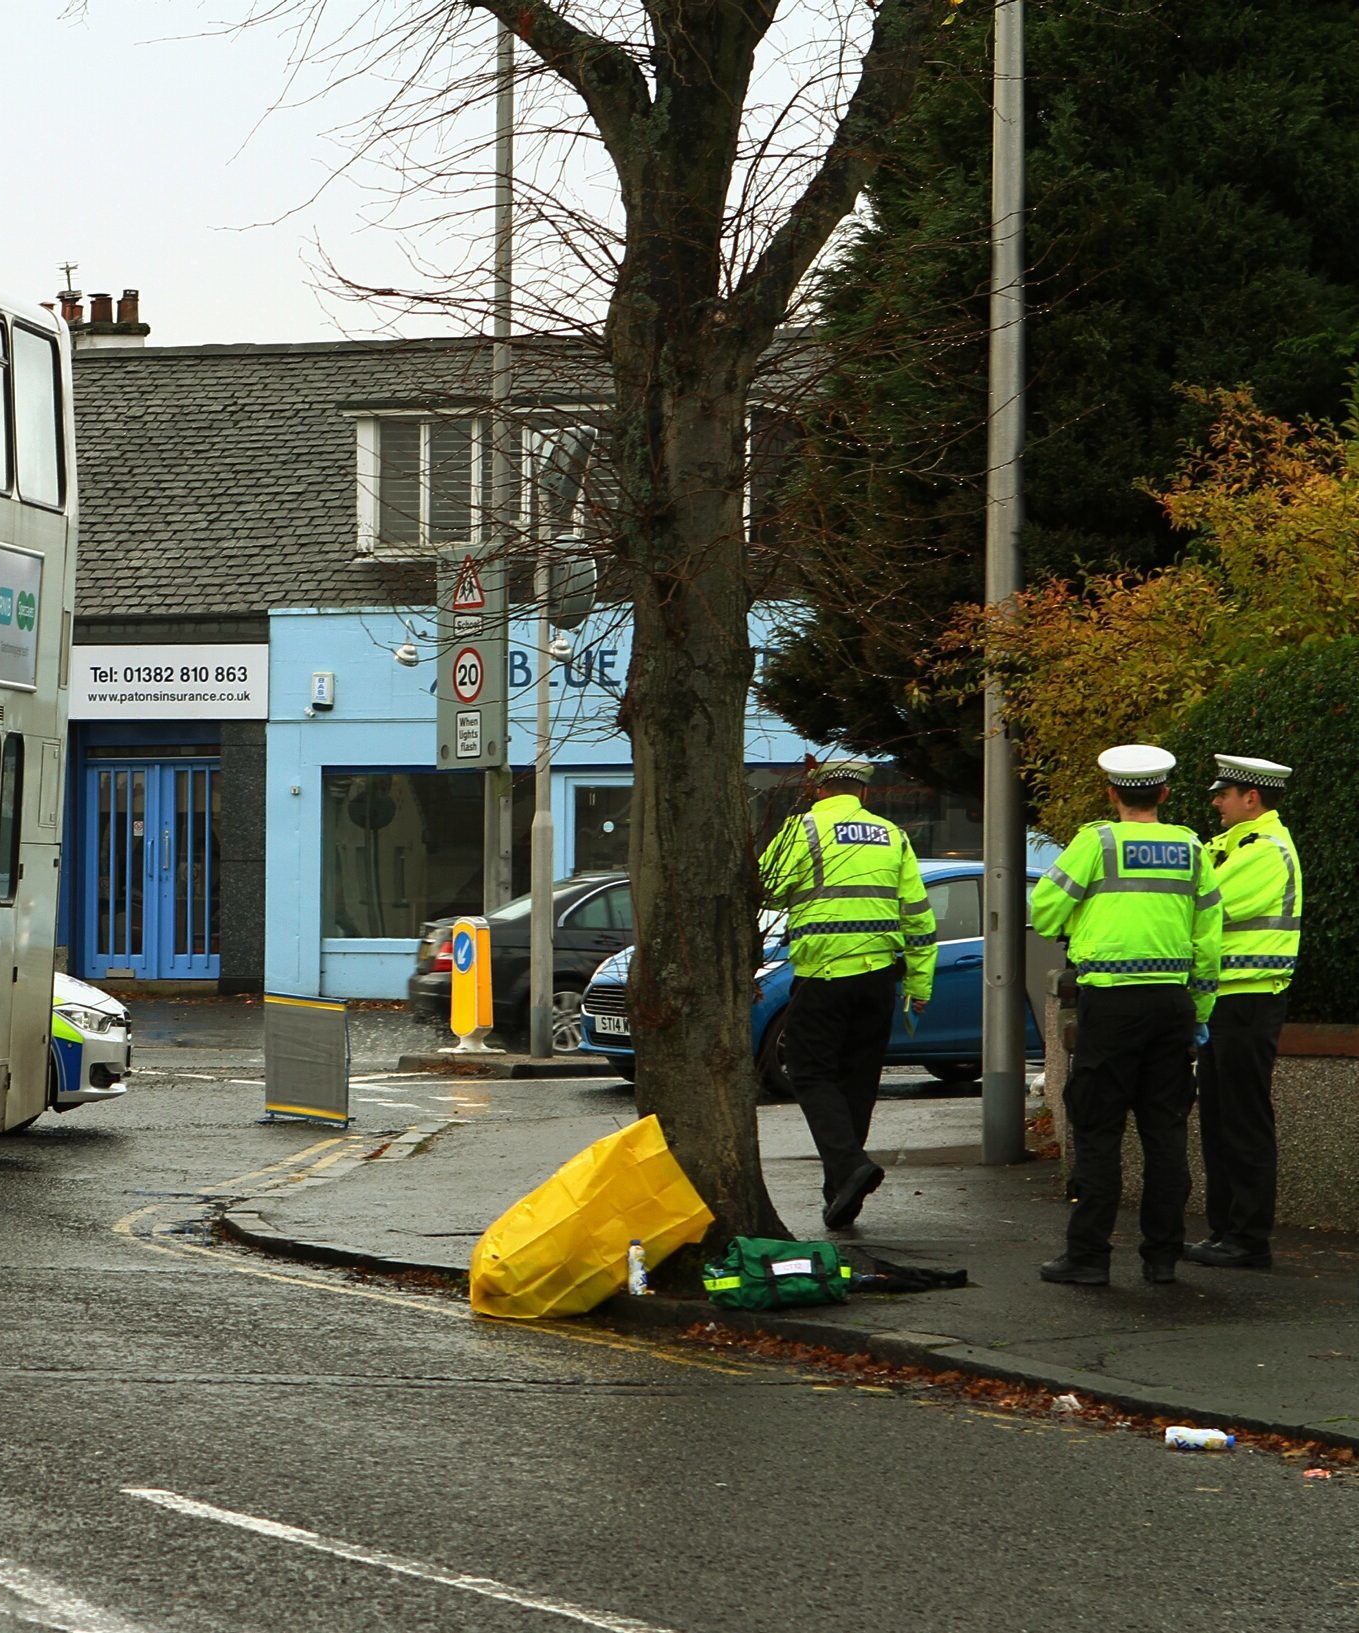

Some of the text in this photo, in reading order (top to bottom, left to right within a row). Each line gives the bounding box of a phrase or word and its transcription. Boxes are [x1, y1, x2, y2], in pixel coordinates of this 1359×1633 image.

[457, 619, 481, 630] School
[90, 666, 248, 683] Tel: 01382 810 863
[458, 663, 479, 686] 20
[88, 690, 251, 704] www.patonsinsurance.co.uk
[459, 717, 479, 727] When
[459, 729, 479, 741] lights
[460, 741, 478, 751] flash
[836, 824, 889, 843] POLICE
[1126, 845, 1188, 865] POLICE
